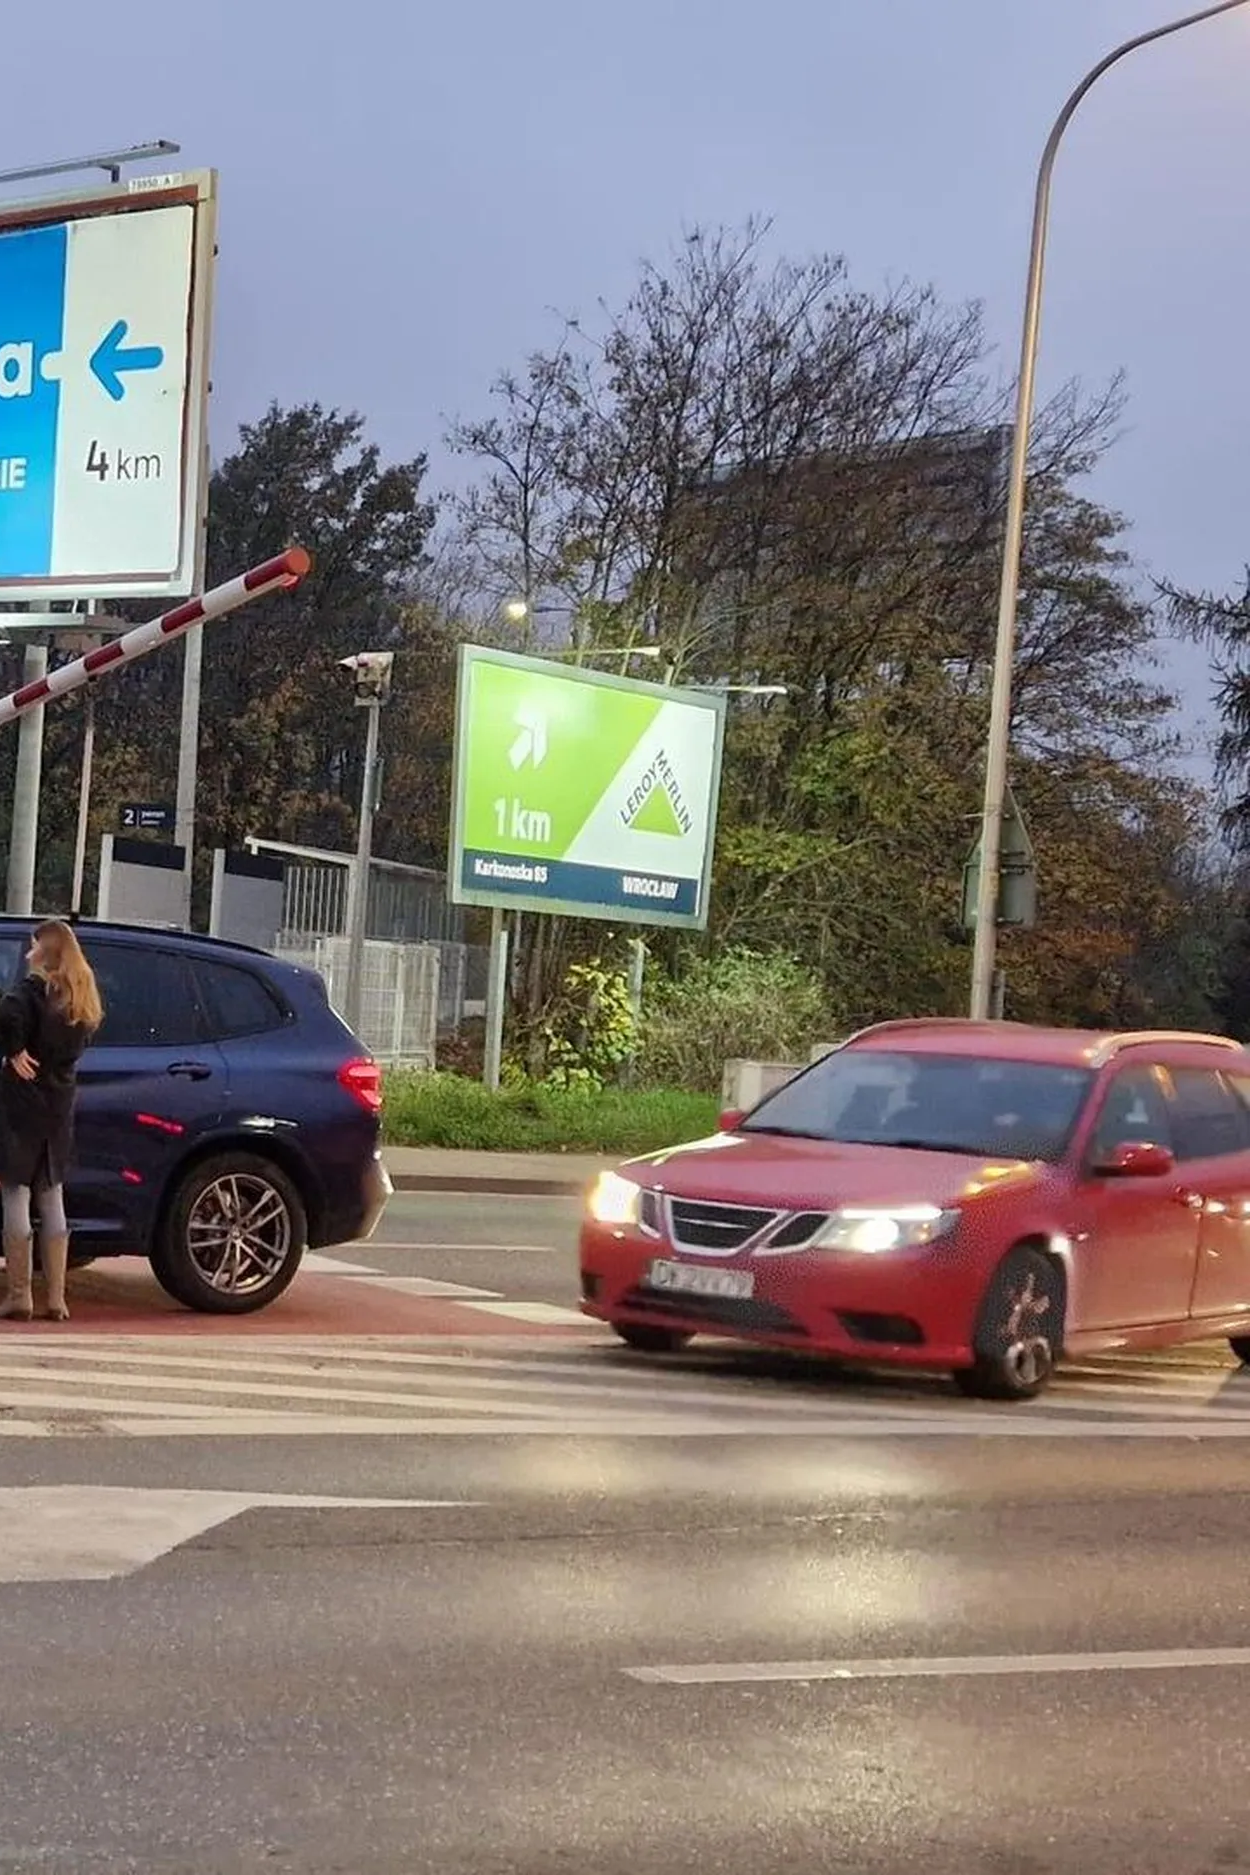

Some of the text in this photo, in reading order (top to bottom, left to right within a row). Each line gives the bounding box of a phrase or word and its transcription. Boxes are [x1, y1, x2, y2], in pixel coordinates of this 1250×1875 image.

[85, 440, 162, 482] 4 km
[619, 762, 658, 825] LEROY
[655, 750, 693, 834] MERLIN
[124, 809, 134, 825] 2
[494, 797, 551, 843] 1 km
[622, 876, 678, 899] WROCŁAW
